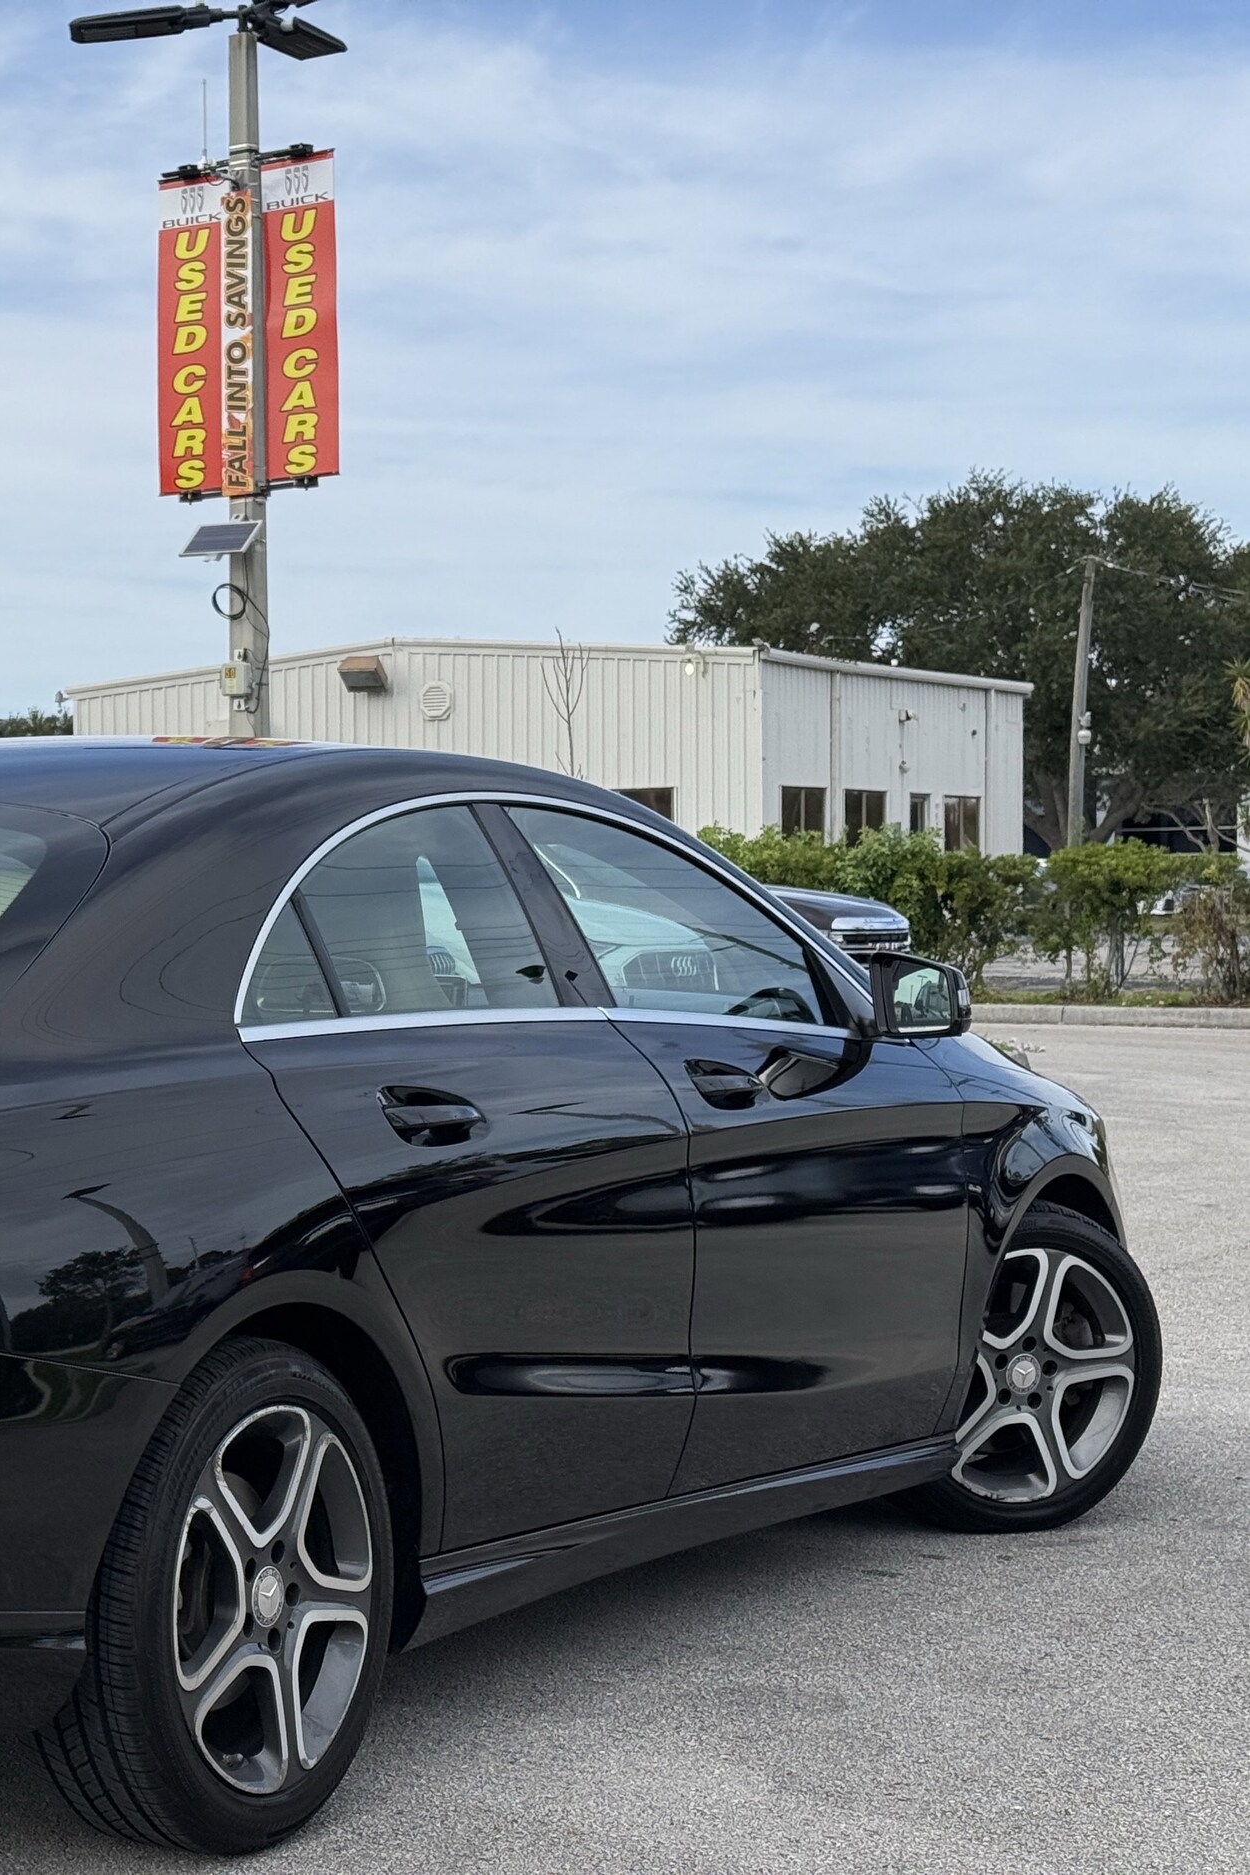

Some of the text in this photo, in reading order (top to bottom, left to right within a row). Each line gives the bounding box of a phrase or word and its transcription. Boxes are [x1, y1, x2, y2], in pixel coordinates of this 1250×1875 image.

[162, 212, 222, 229] BUICK
[266, 192, 329, 210] BUICK
[170, 228, 211, 490] USED CARS
[225, 195, 249, 490] FALL INTO SAVINGS
[279, 208, 319, 475] USED CARS
